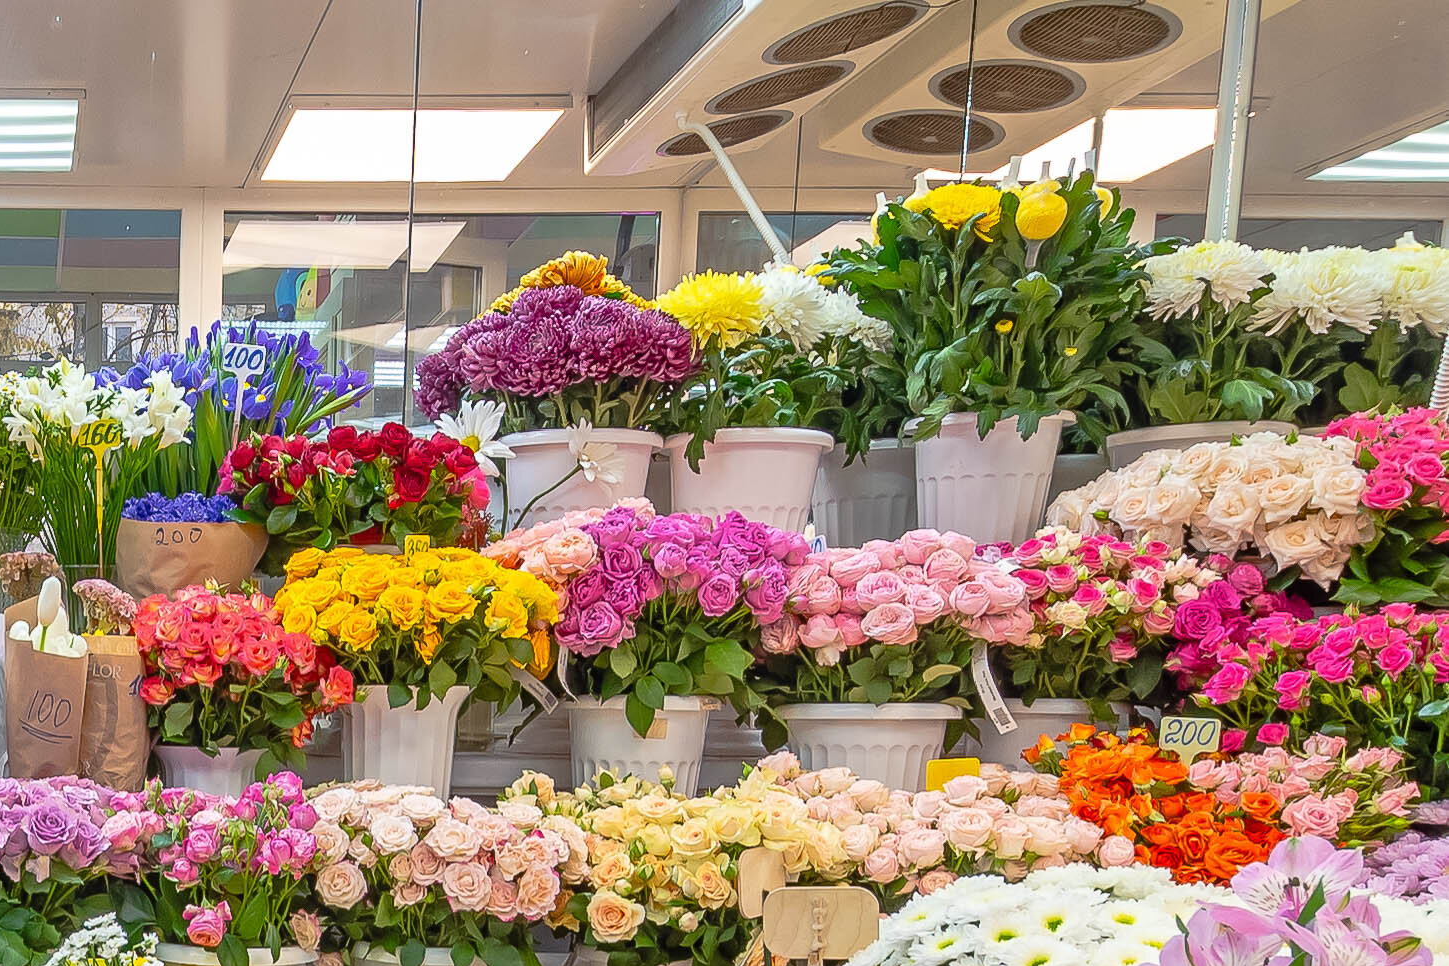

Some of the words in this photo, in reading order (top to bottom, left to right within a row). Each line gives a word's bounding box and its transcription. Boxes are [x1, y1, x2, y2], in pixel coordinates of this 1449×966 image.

[224, 345, 264, 370] 100
[81, 422, 119, 446] 160
[155, 527, 203, 546] 200
[27, 689, 72, 728] 100
[1165, 718, 1217, 746] 200
